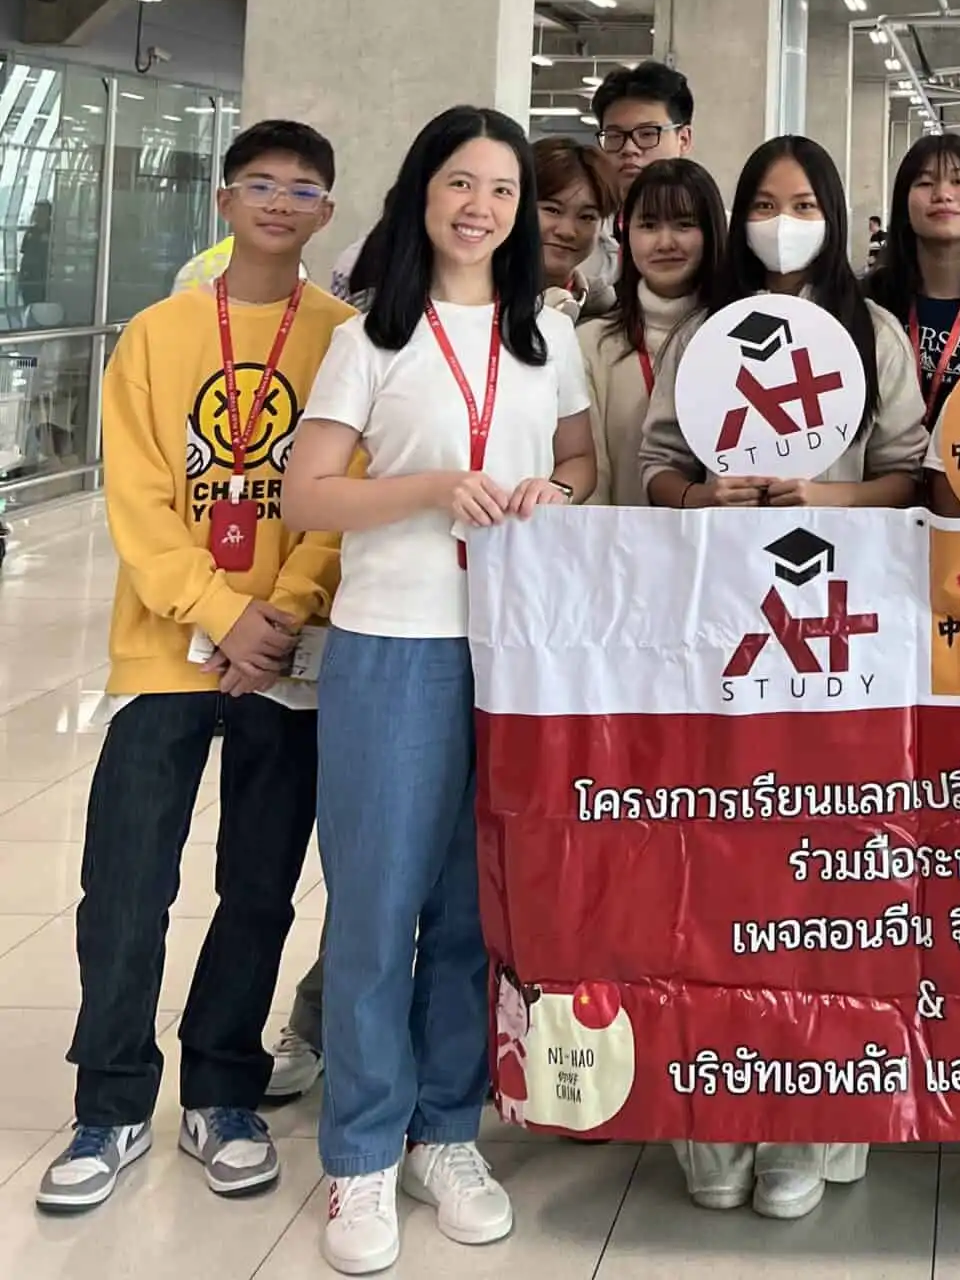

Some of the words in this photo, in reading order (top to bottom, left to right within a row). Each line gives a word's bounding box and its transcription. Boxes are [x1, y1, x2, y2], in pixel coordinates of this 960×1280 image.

[717, 423, 850, 473] STUDY
[721, 673, 876, 702] STUDY
[732, 902, 934, 955] เพจสอนจีน
[916, 980, 945, 1019] &
[547, 1047, 595, 1068] NI-HAO
[668, 1043, 910, 1096] บริษัทเอพลัส
[555, 1083, 582, 1104] CHINA
